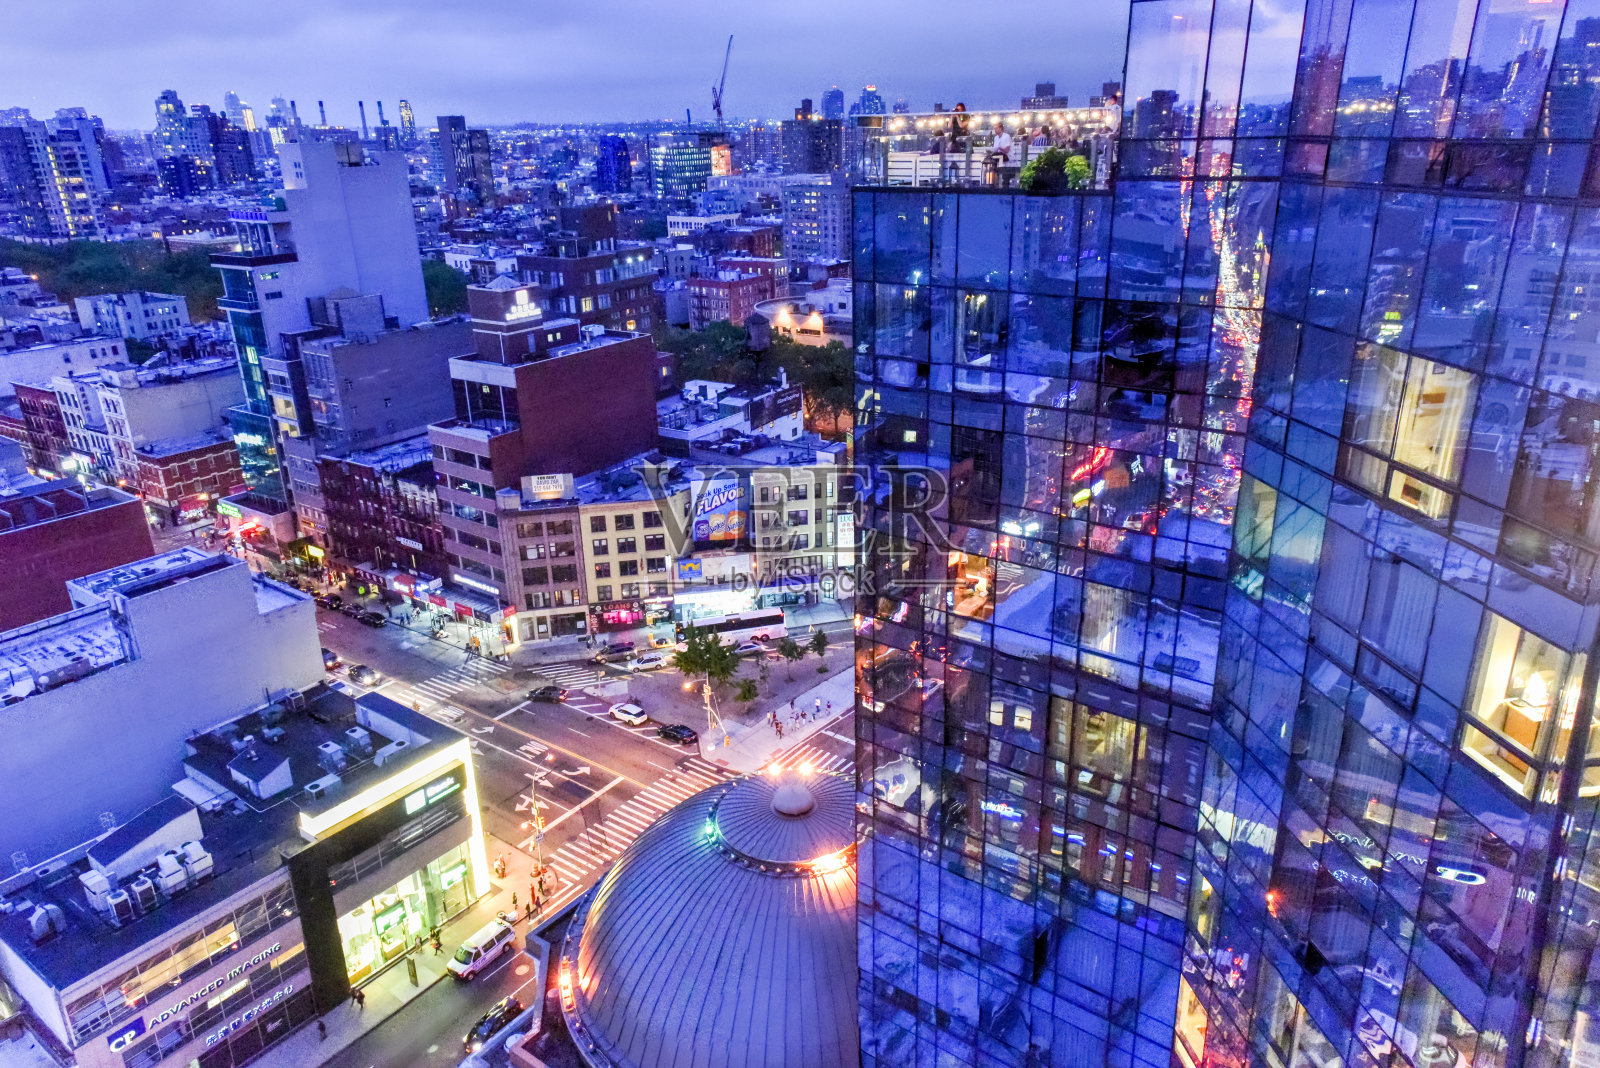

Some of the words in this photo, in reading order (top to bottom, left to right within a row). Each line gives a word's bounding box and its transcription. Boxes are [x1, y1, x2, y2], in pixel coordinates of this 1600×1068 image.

[696, 486, 745, 517] FLAVOR
[713, 488, 722, 496] Up
[603, 602, 631, 611] LOANS
[109, 1030, 136, 1053] CP
[148, 977, 225, 1030] ADVANCED
[226, 942, 282, 982] IMAGING
